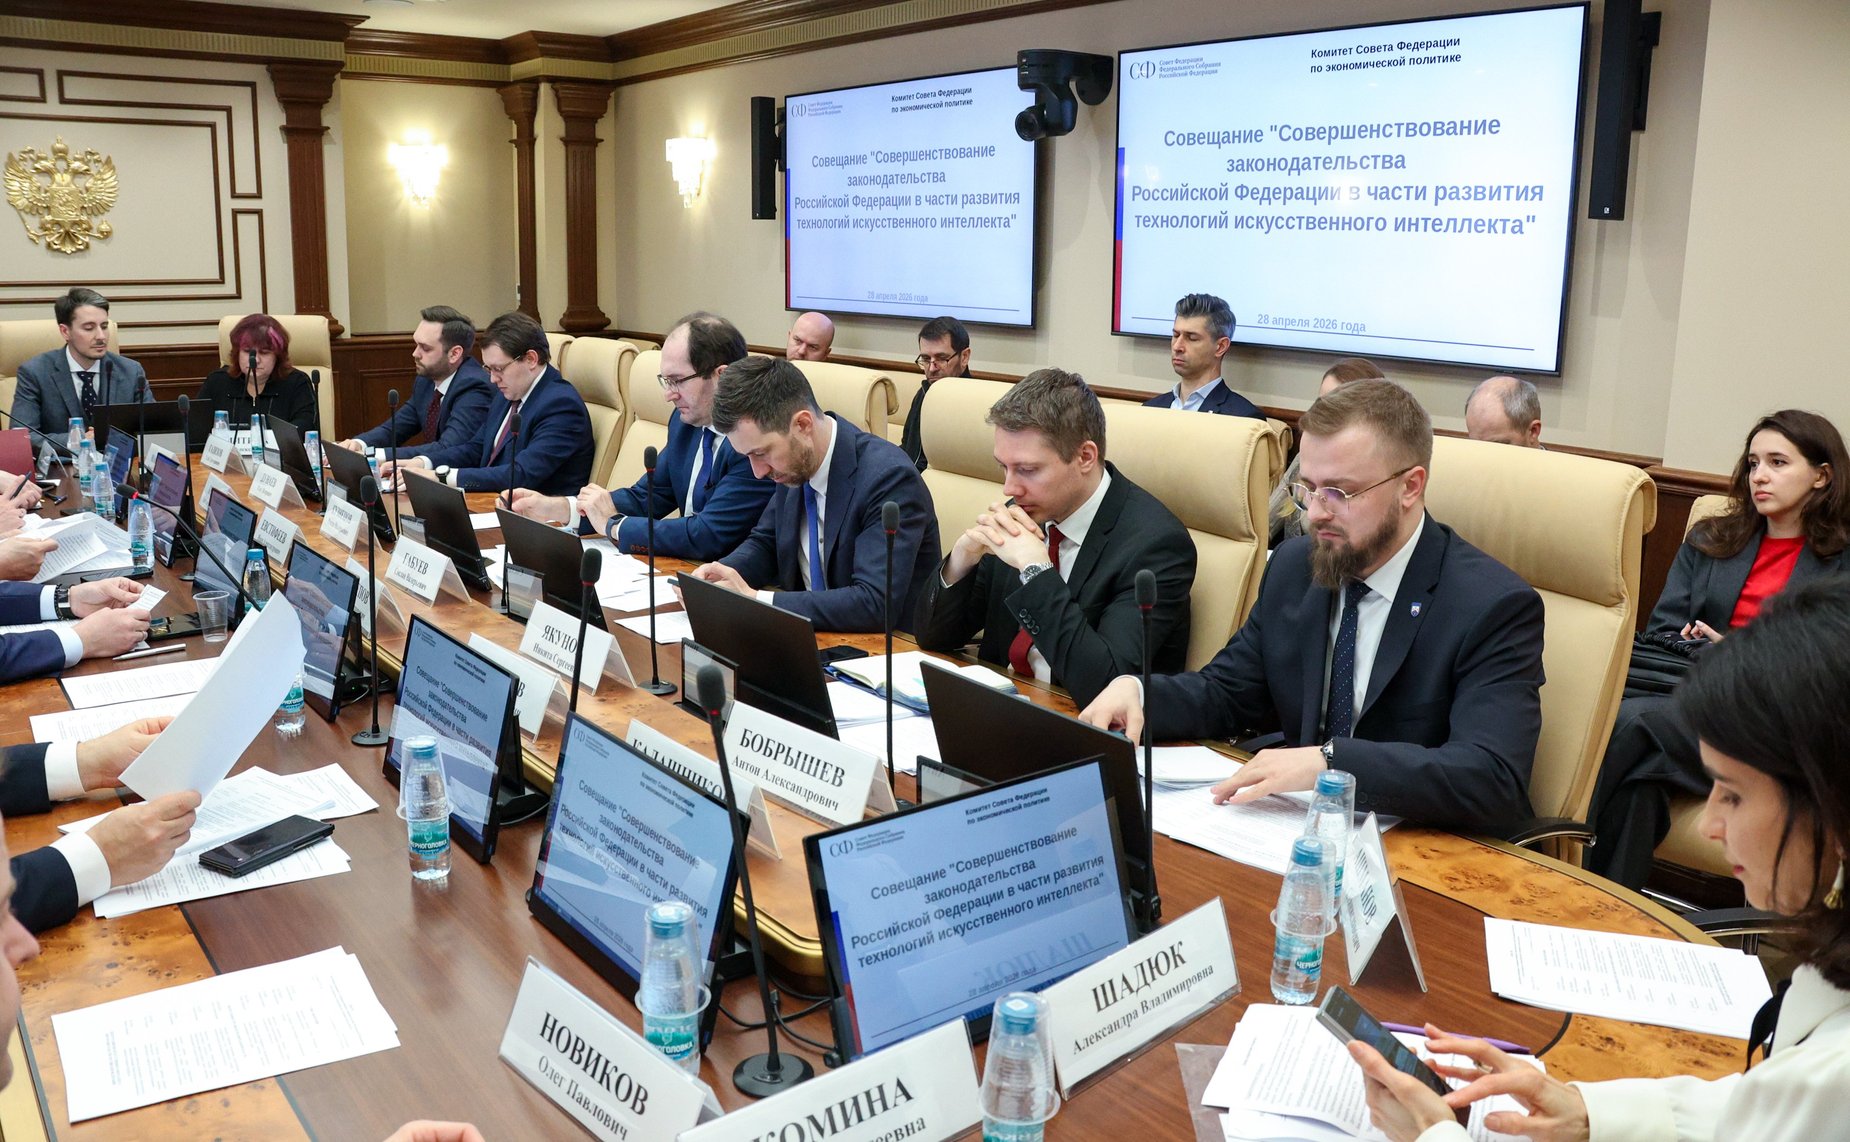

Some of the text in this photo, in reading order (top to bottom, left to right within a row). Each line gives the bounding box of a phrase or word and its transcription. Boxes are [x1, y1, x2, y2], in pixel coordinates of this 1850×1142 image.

[1311, 37, 1460, 58] Комитет Совета Федерации
[1129, 61, 1156, 80] СФ
[1310, 52, 1461, 74] по экономической политике
[891, 87, 972, 102] Комитет Совета Федерации
[899, 101, 943, 112] экономической
[944, 98, 973, 108] политике
[1163, 116, 1501, 150] Совещание "Совершенствование
[812, 143, 996, 169] Совещание "Совершенствование
[1226, 152, 1406, 177] законодательства
[847, 170, 946, 189] законодательства
[1131, 182, 1544, 205] Российской Федерации в части развития
[794, 190, 1020, 210] Российской Федерации в части развития
[797, 213, 1017, 232] технологий искусственного интеллекта"
[1135, 210, 1536, 236] технологий искусственного интеллекта"
[876, 292, 898, 303] апреля
[899, 292, 913, 302] 2026
[913, 294, 928, 304] года
[1257, 313, 1366, 334] 28 апреля 2026 года
[403, 552, 429, 575] ГАБУЕВ
[541, 624, 579, 653] ЯКУНО
[533, 642, 575, 672] Никита Сергеев
[632, 738, 726, 800] КАЛАШНИКО
[739, 728, 845, 788] БОБРЫШЕВ
[732, 756, 839, 811] Антон Александрович
[965, 787, 1048, 816] Комитет Совета Федерации
[977, 804, 1022, 823] экономической
[1023, 796, 1050, 808] политике
[579, 779, 700, 870] Совещание "Совершенствование
[599, 814, 664, 866] законодательства
[829, 840, 854, 858] СФ
[559, 823, 651, 899] технологий искусственного
[561, 803, 708, 919] Российской Федерации в части развития
[871, 867, 947, 900] Совещание
[949, 826, 1078, 873] "Совершенствование
[924, 859, 1036, 904] законодательства
[851, 855, 1104, 949] Российской Федерации в части развития
[858, 872, 1104, 968] технологий искусственного интеллекта"
[1091, 941, 1186, 1013] ШАДЮК
[1297, 961, 1320, 969] ЧЕРНОГ
[1073, 965, 1214, 1054] Александра Владимировна
[539, 1011, 649, 1116] НОВИКОВ
[538, 1055, 628, 1141] Олег Павлович
[869, 1116, 926, 1142] еевна
